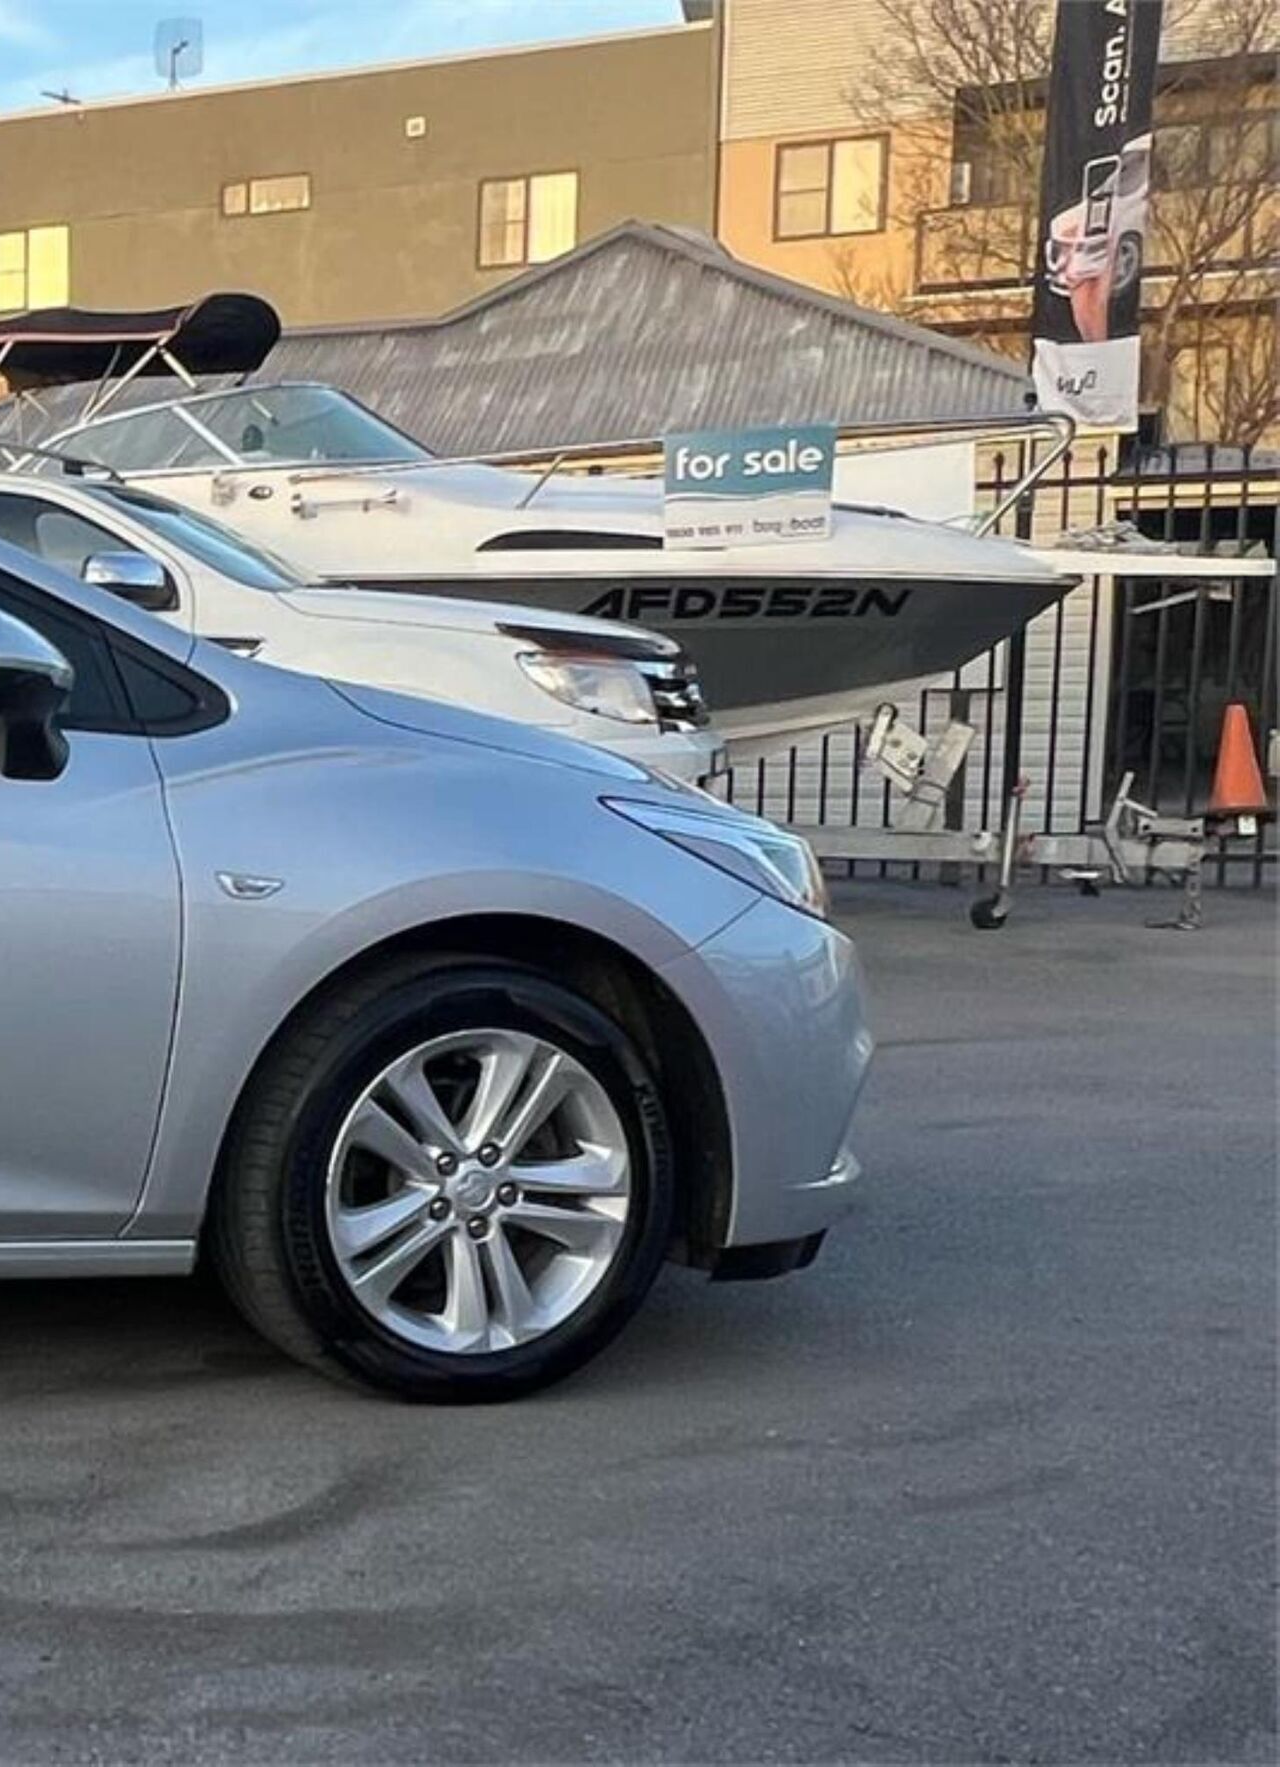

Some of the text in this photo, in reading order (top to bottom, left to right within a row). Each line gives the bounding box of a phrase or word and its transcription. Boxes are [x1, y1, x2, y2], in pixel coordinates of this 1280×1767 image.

[1094, 25, 1126, 127] Scan.
[676, 439, 824, 480] for sale
[576, 587, 914, 619] AFD552N
